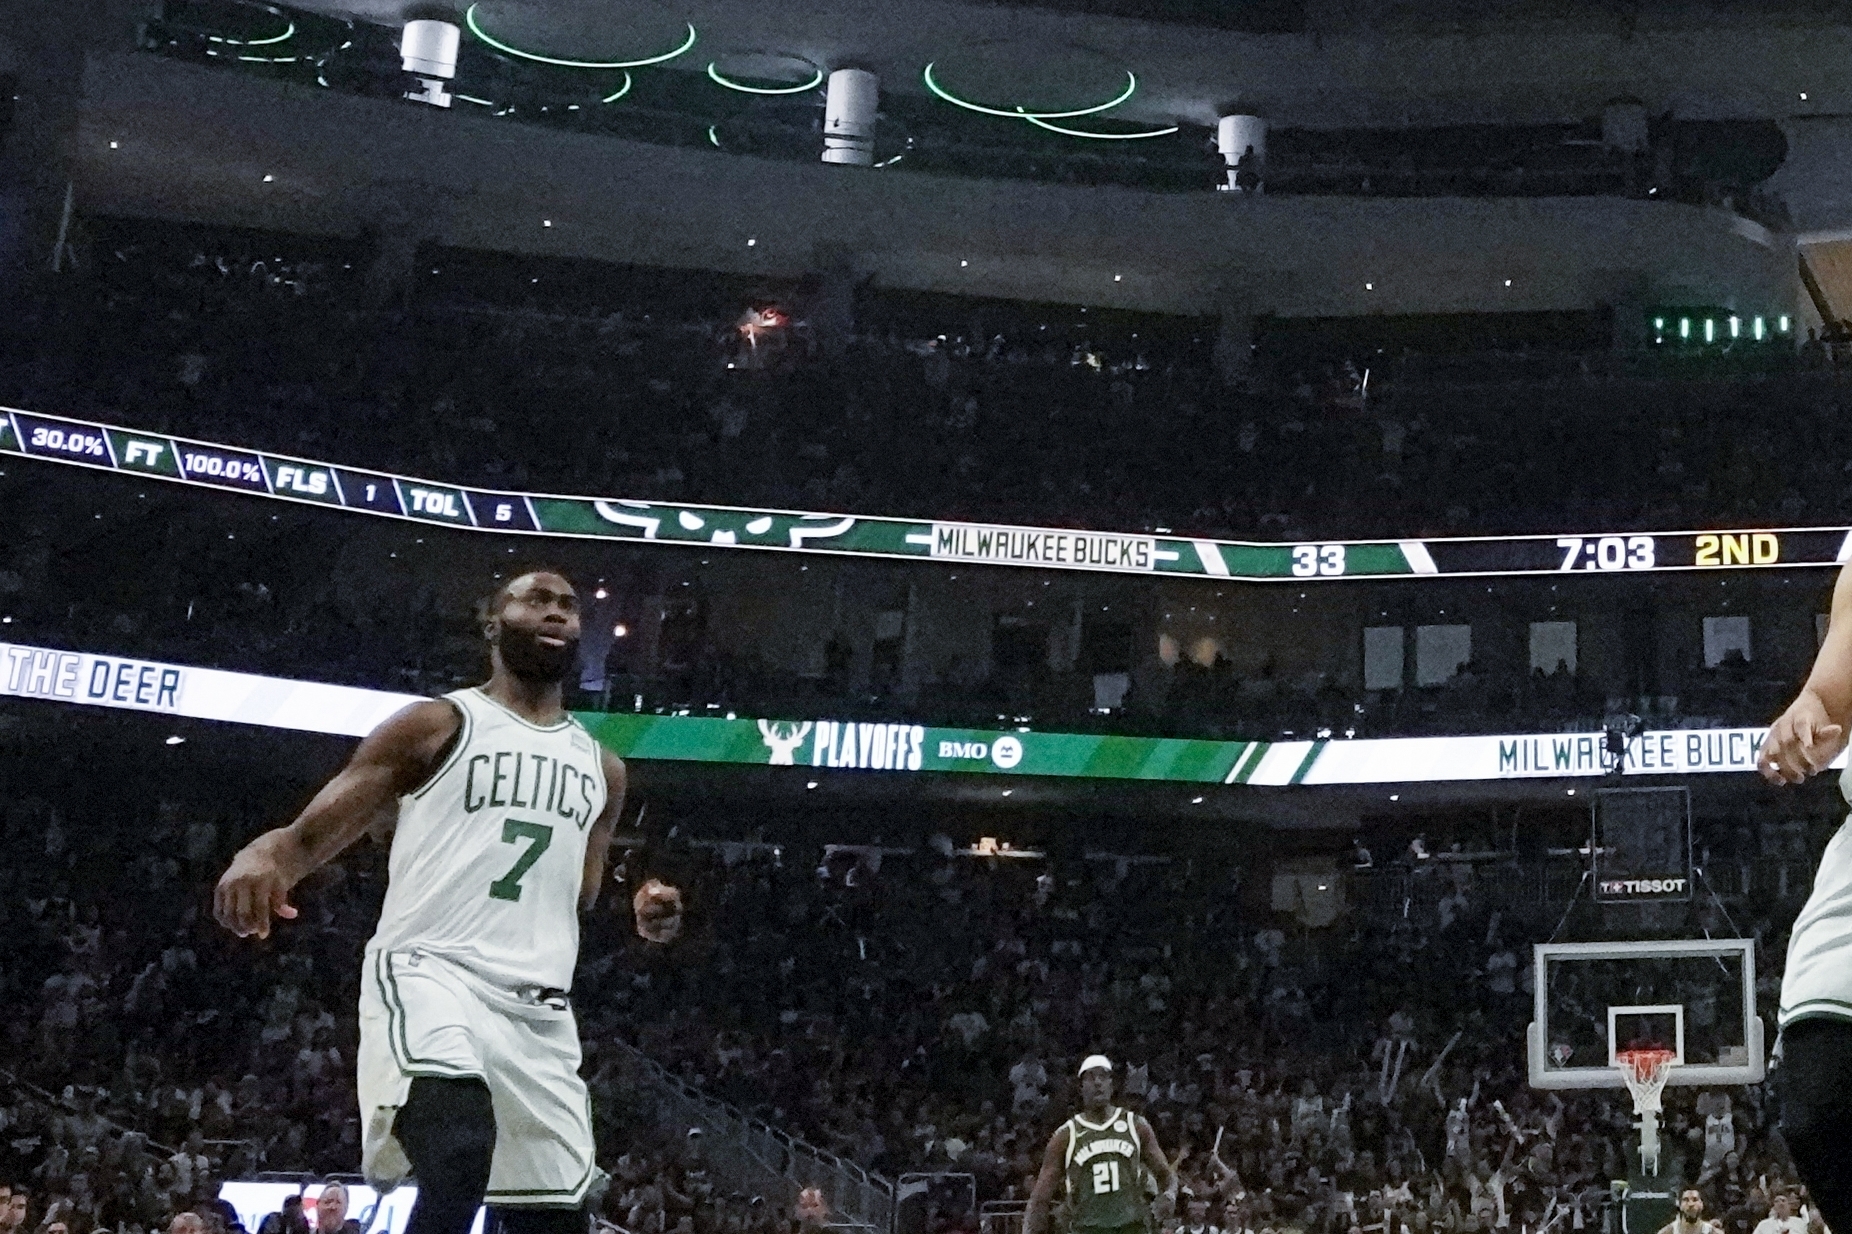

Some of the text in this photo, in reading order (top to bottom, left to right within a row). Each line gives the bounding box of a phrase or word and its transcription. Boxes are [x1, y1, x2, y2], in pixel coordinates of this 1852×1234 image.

[32, 428, 511, 521] 30.0% FT 100.0% FLS 1 TOL 5
[938, 527, 1149, 567] MILWAUKEE BUCKS
[1292, 544, 1345, 577] 33
[1557, 533, 1779, 571] 7:03 2ND
[7, 647, 180, 707] THE DEER
[813, 721, 924, 771] PLAYOFFS
[939, 741, 987, 760] BMO
[1687, 732, 1765, 767] BUCK
[464, 751, 596, 831] CELTICS
[489, 819, 554, 902] 7
[1624, 878, 1687, 893] TISSOT
[1093, 1161, 1119, 1194] 21
